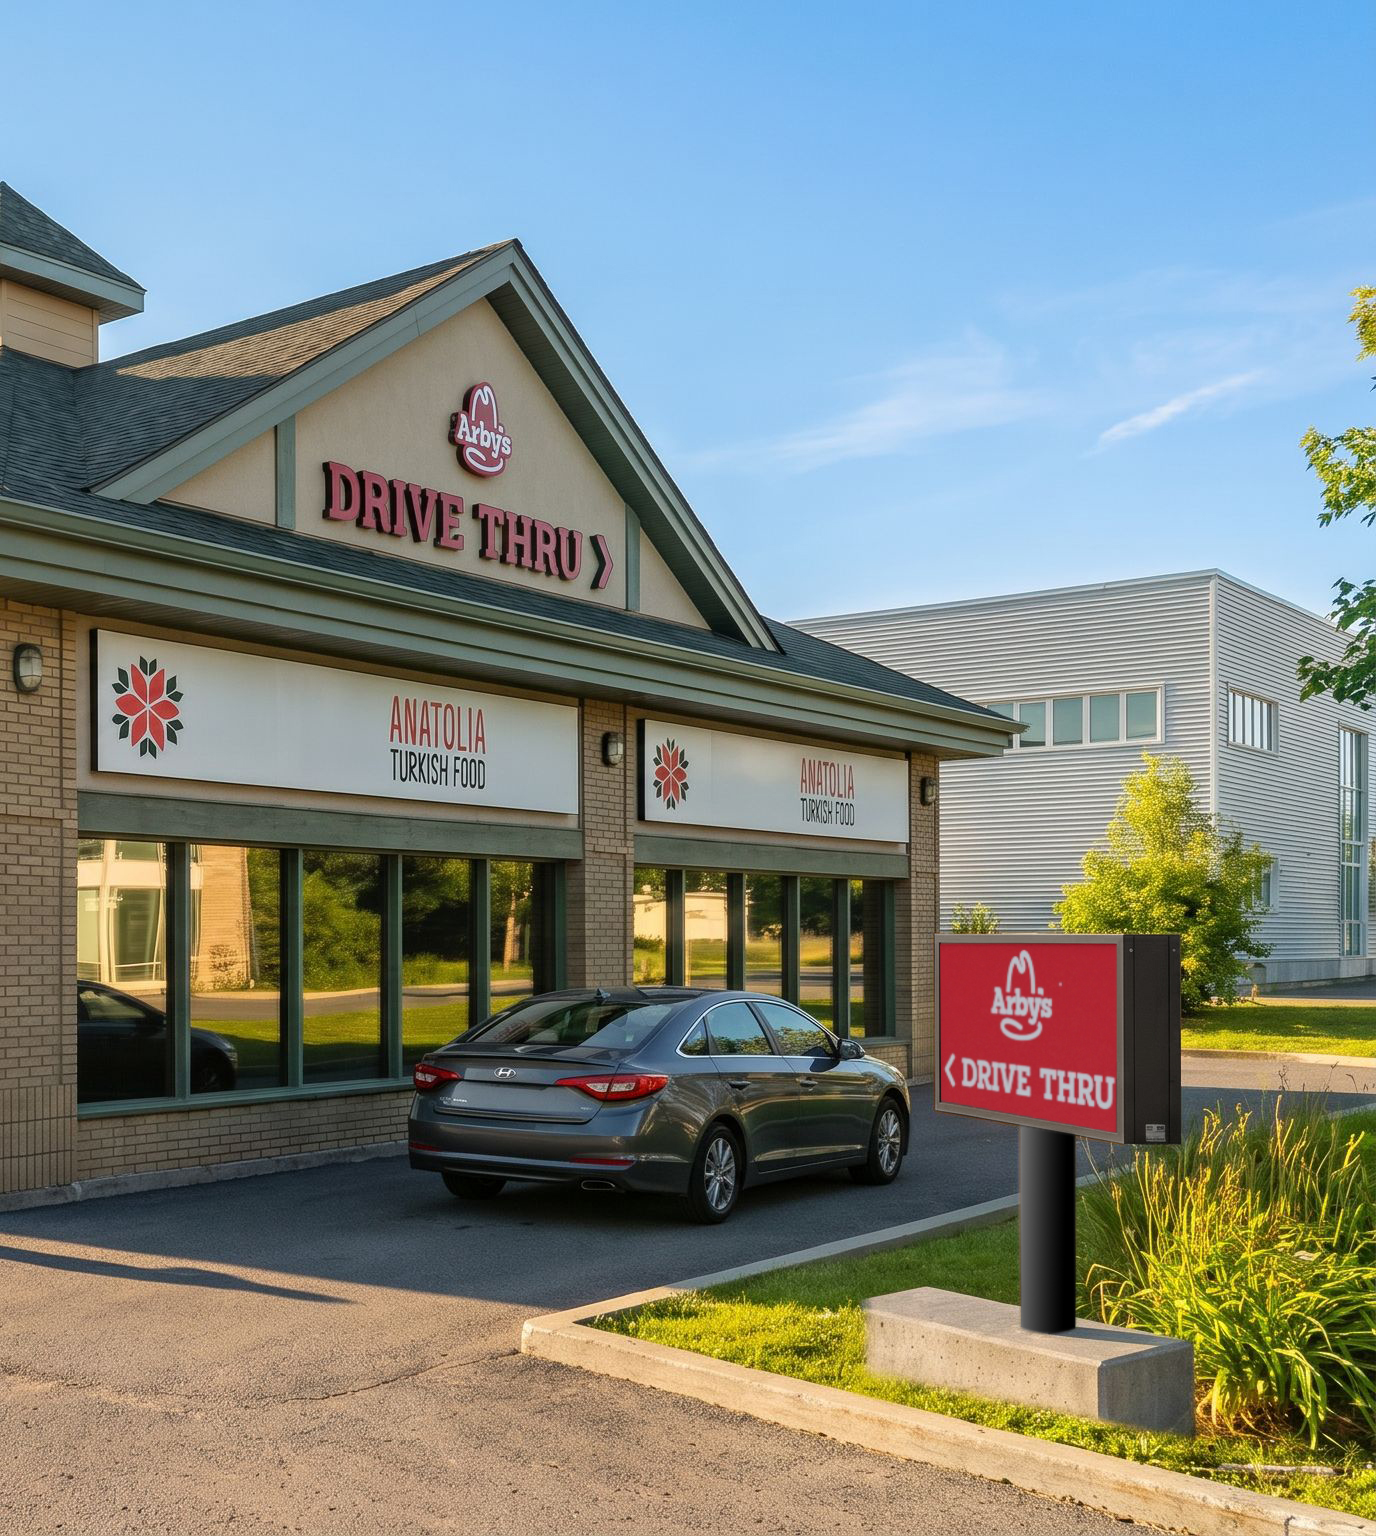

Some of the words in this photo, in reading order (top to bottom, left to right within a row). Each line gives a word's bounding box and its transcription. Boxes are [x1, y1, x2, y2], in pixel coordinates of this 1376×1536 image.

[457, 413, 511, 459] Arby's
[323, 461, 464, 551] DRIVE
[473, 503, 583, 581] THRU
[389, 695, 486, 755] ANATOLIA
[390, 748, 448, 787] TURKISH
[453, 756, 486, 790] FOOD
[800, 757, 855, 800] ANATOLIA
[800, 797, 833, 825] TURKISH
[835, 801, 855, 826] FOOD
[990, 986, 1053, 1025] Arby's
[961, 1057, 1031, 1097] DRIVE
[1039, 1067, 1116, 1110] THRU
